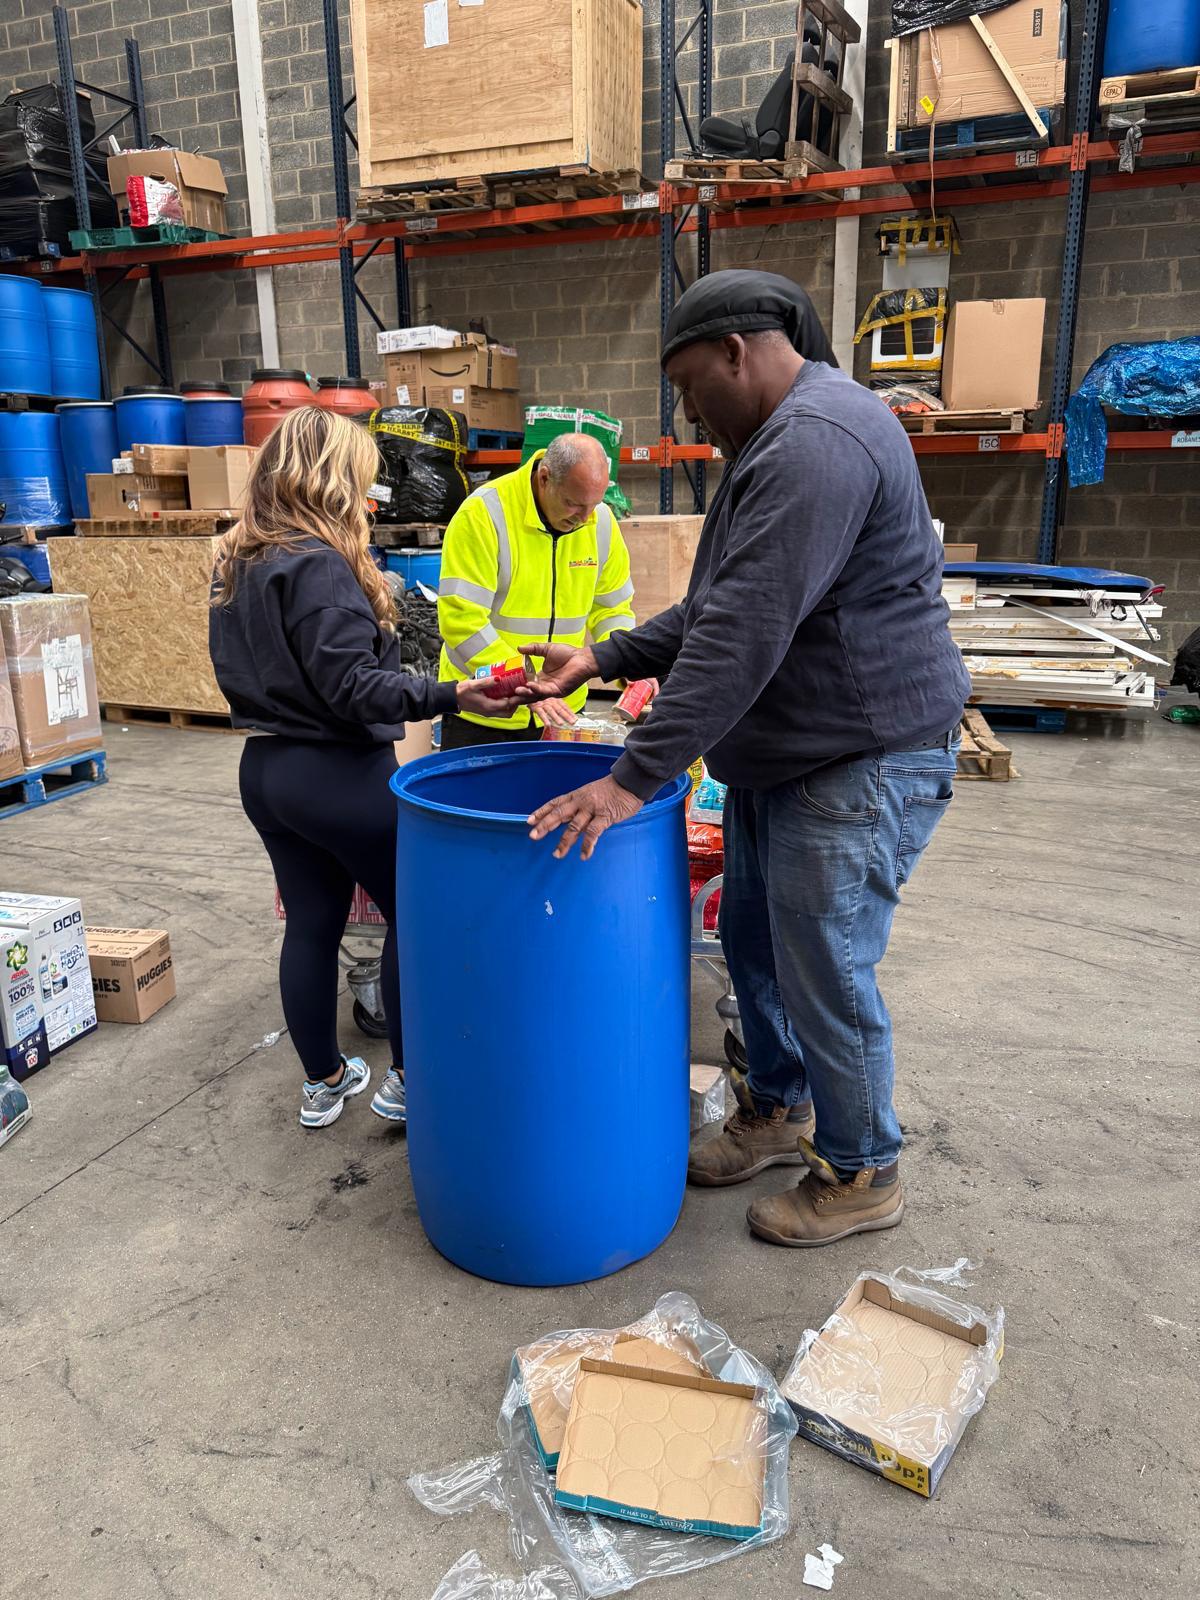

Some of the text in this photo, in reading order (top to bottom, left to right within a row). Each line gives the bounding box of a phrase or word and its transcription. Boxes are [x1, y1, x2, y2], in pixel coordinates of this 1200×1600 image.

[981, 438, 999, 448] 15C
[137, 955, 172, 991] HUGGIES
[9, 982, 35, 1002] 100%
[28, 1056, 36, 1065] 100
